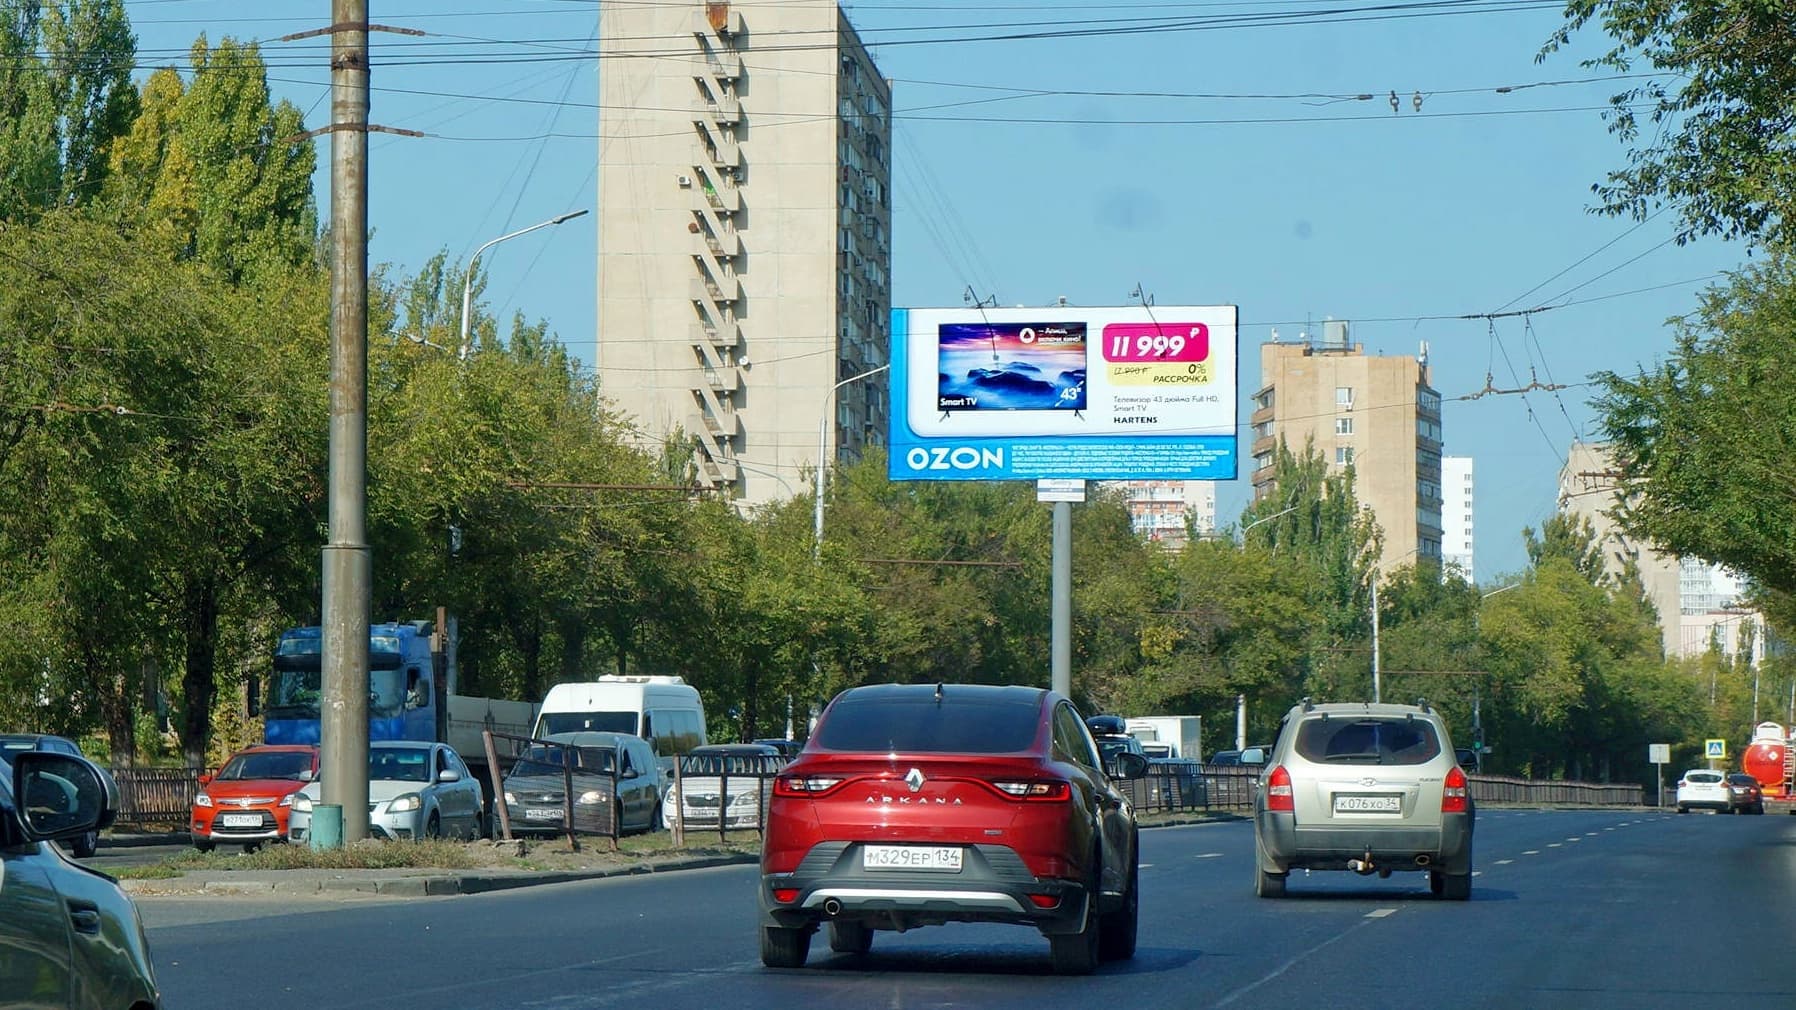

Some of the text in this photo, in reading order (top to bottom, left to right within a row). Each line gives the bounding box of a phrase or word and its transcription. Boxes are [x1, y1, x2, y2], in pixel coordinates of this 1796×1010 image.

[1136, 335, 1186, 357] 999
[1188, 363, 1207, 375] 0%
[1152, 375, 1208, 383] РАССРОЧКА
[940, 396, 977, 408] Smart TV
[1113, 395, 1152, 404] Телевизор
[1153, 395, 1163, 403] 43
[1191, 395, 1205, 403] Full
[1113, 404, 1147, 412] Smart TV
[1113, 416, 1158, 424] HARTENS
[906, 447, 1004, 471] OZON
[865, 796, 963, 805] ARKANA
[934, 849, 961, 862] 134
